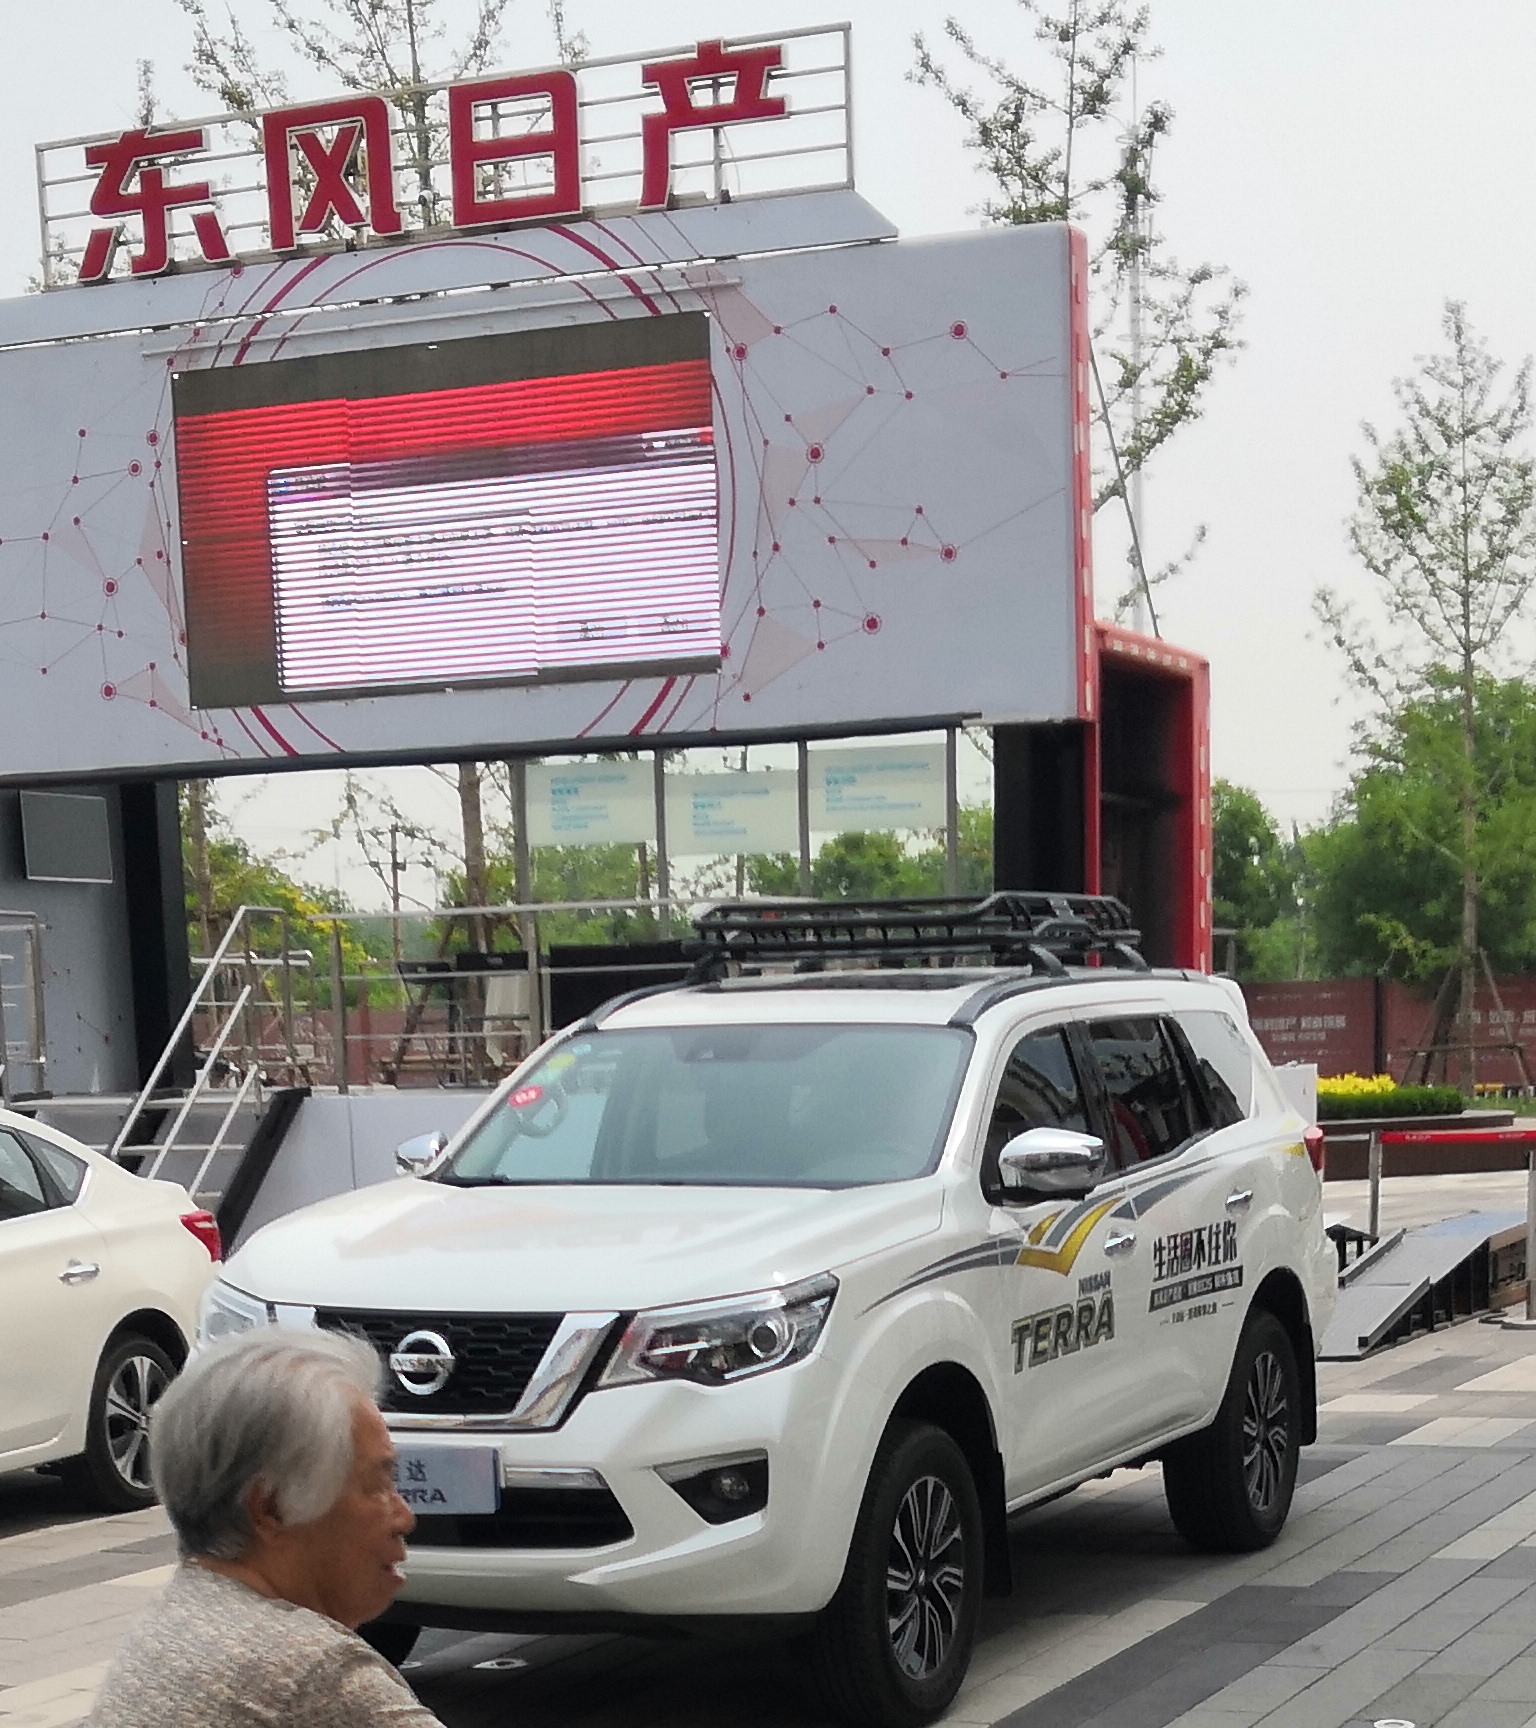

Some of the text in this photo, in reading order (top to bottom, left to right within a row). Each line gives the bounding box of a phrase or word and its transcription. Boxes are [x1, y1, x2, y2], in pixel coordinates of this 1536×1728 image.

[78, 40, 789, 281] 东风日产
[1011, 1288, 1115, 1376] TERRA
[397, 1488, 447, 1503] RRA
